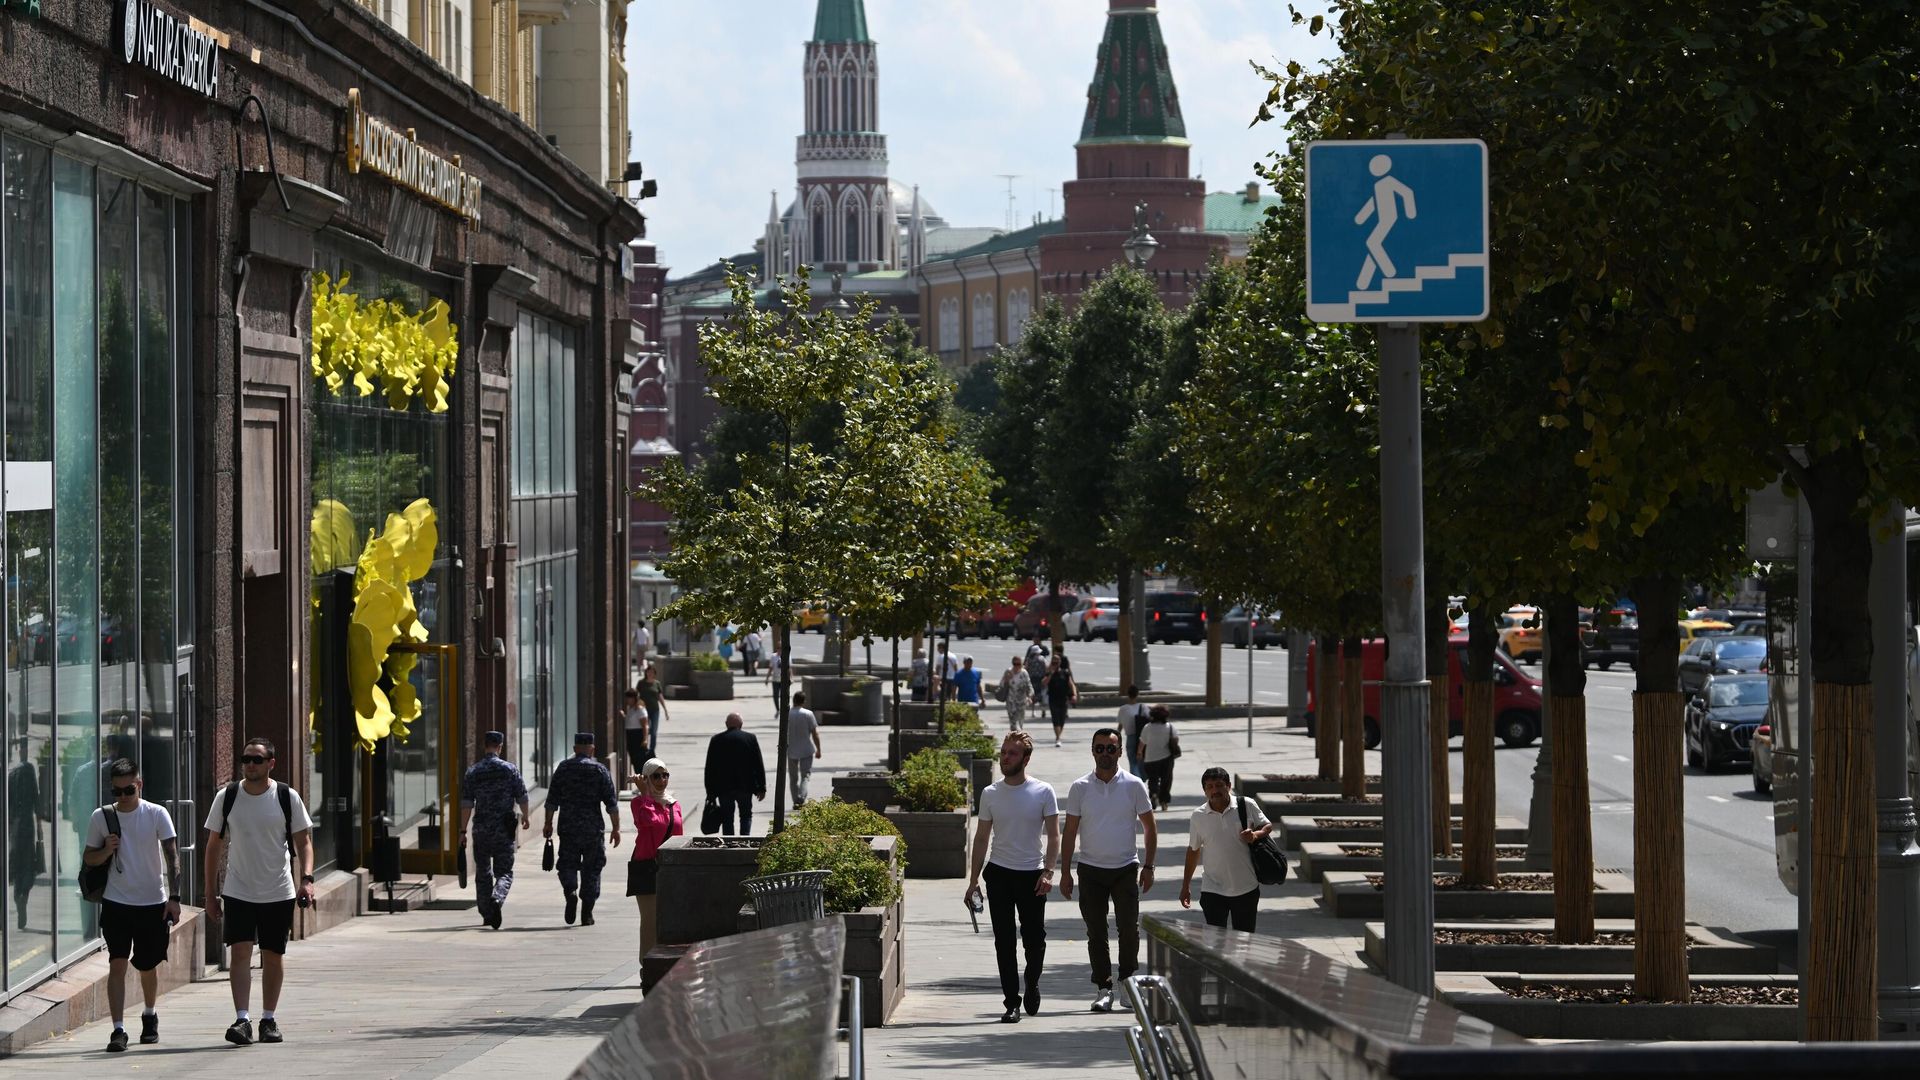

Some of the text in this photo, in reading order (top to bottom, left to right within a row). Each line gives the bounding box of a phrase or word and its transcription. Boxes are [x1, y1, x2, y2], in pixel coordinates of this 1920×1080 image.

[137, 0, 219, 99] NATURA SIBERICA
[362, 111, 418, 190] МОСКОВСКИЙ
